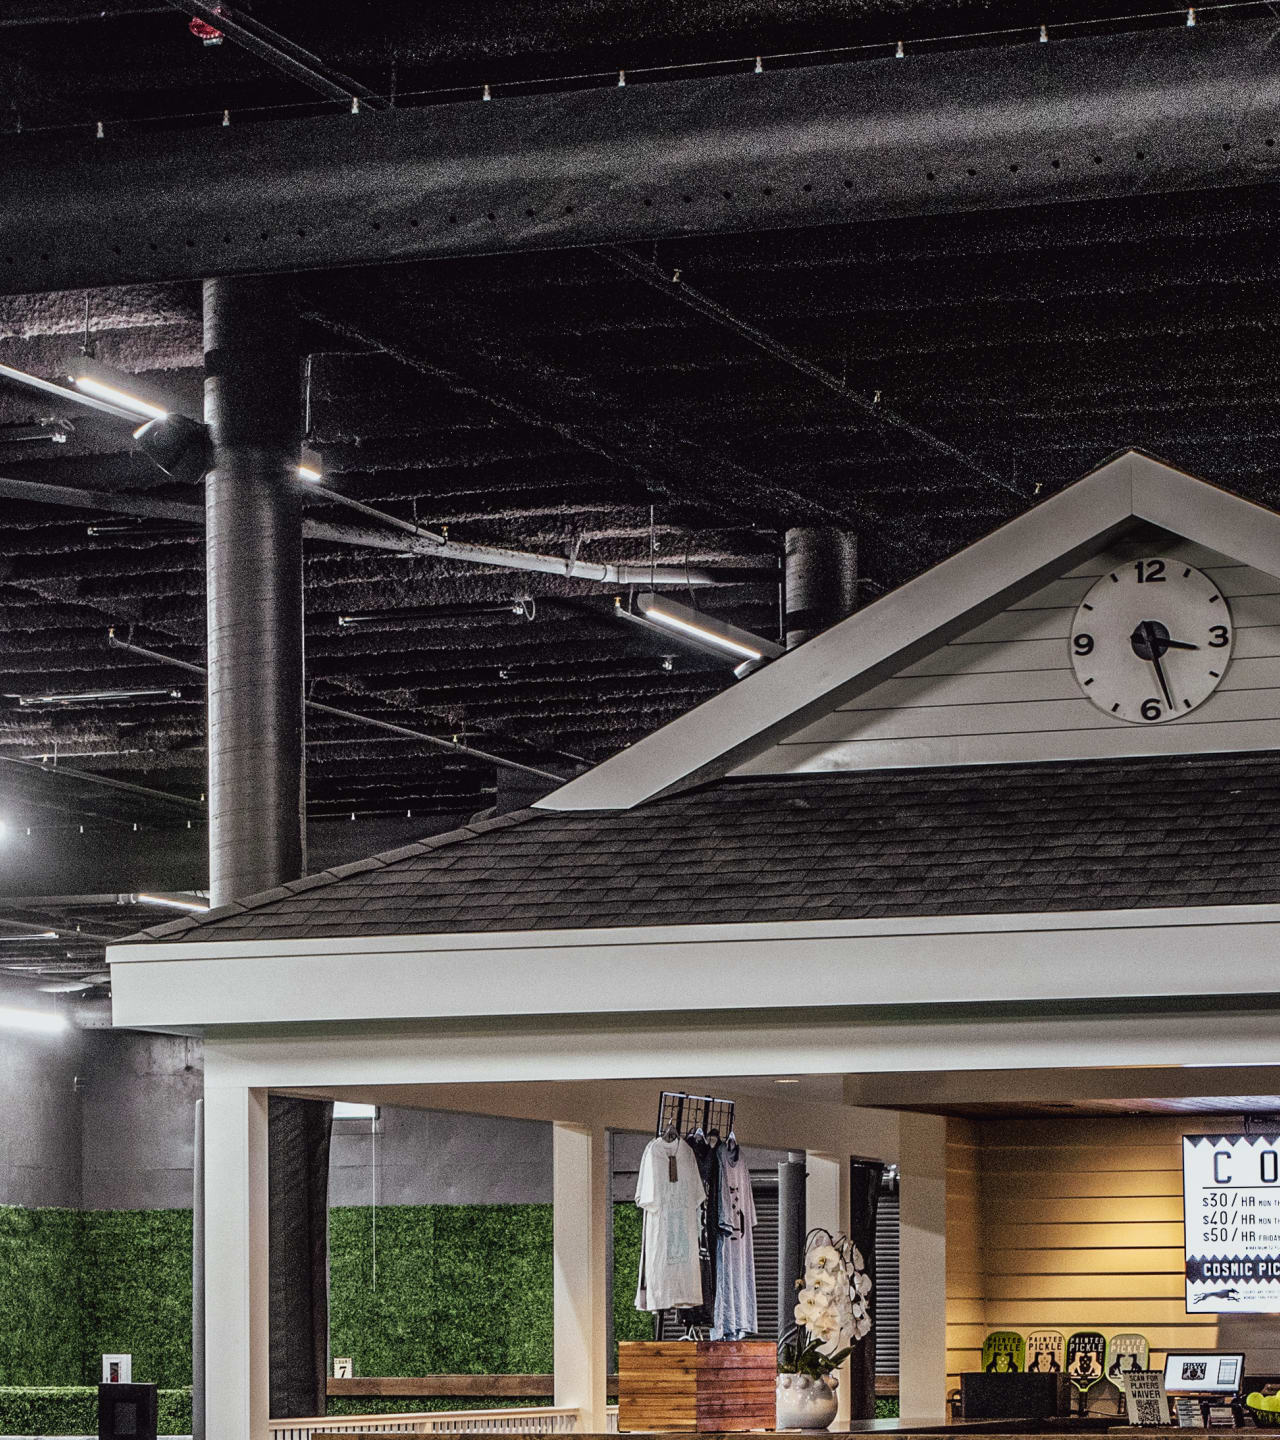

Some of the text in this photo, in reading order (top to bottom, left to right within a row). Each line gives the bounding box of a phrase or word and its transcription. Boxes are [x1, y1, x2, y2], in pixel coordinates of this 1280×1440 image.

[1134, 559, 1166, 584] 12
[1208, 625, 1229, 648] 3
[1073, 633, 1095, 656] 9
[1140, 697, 1162, 721] 6
[1203, 1263, 1252, 1276] COSMIC
[987, 1336, 1022, 1344] PAINTED
[987, 1343, 1020, 1351] PICKLE
[1110, 1345, 1145, 1353] PICKLE
[339, 1366, 347, 1378] 7
[1131, 1390, 1160, 1399] WAIVER
